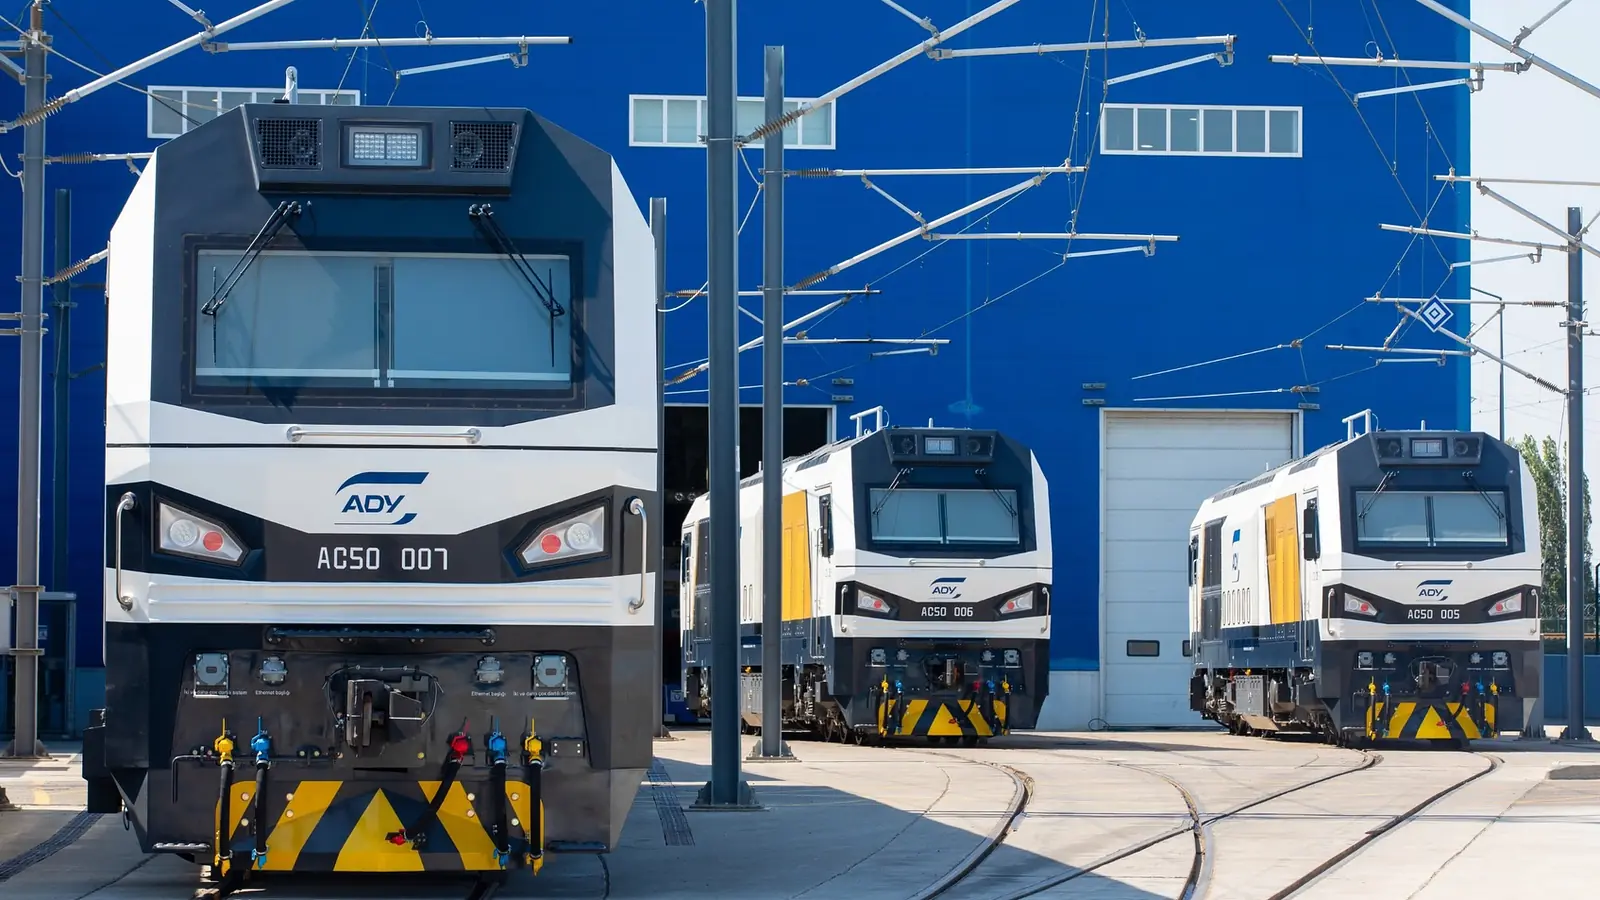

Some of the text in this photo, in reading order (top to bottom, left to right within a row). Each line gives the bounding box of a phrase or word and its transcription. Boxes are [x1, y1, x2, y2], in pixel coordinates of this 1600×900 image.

[341, 494, 405, 513] ADY
[317, 546, 448, 571] AC50 007
[932, 586, 957, 594] ADY
[1418, 588, 1444, 597] ADY
[921, 606, 974, 617] AC50 006
[1407, 609, 1460, 620] AC50 005
